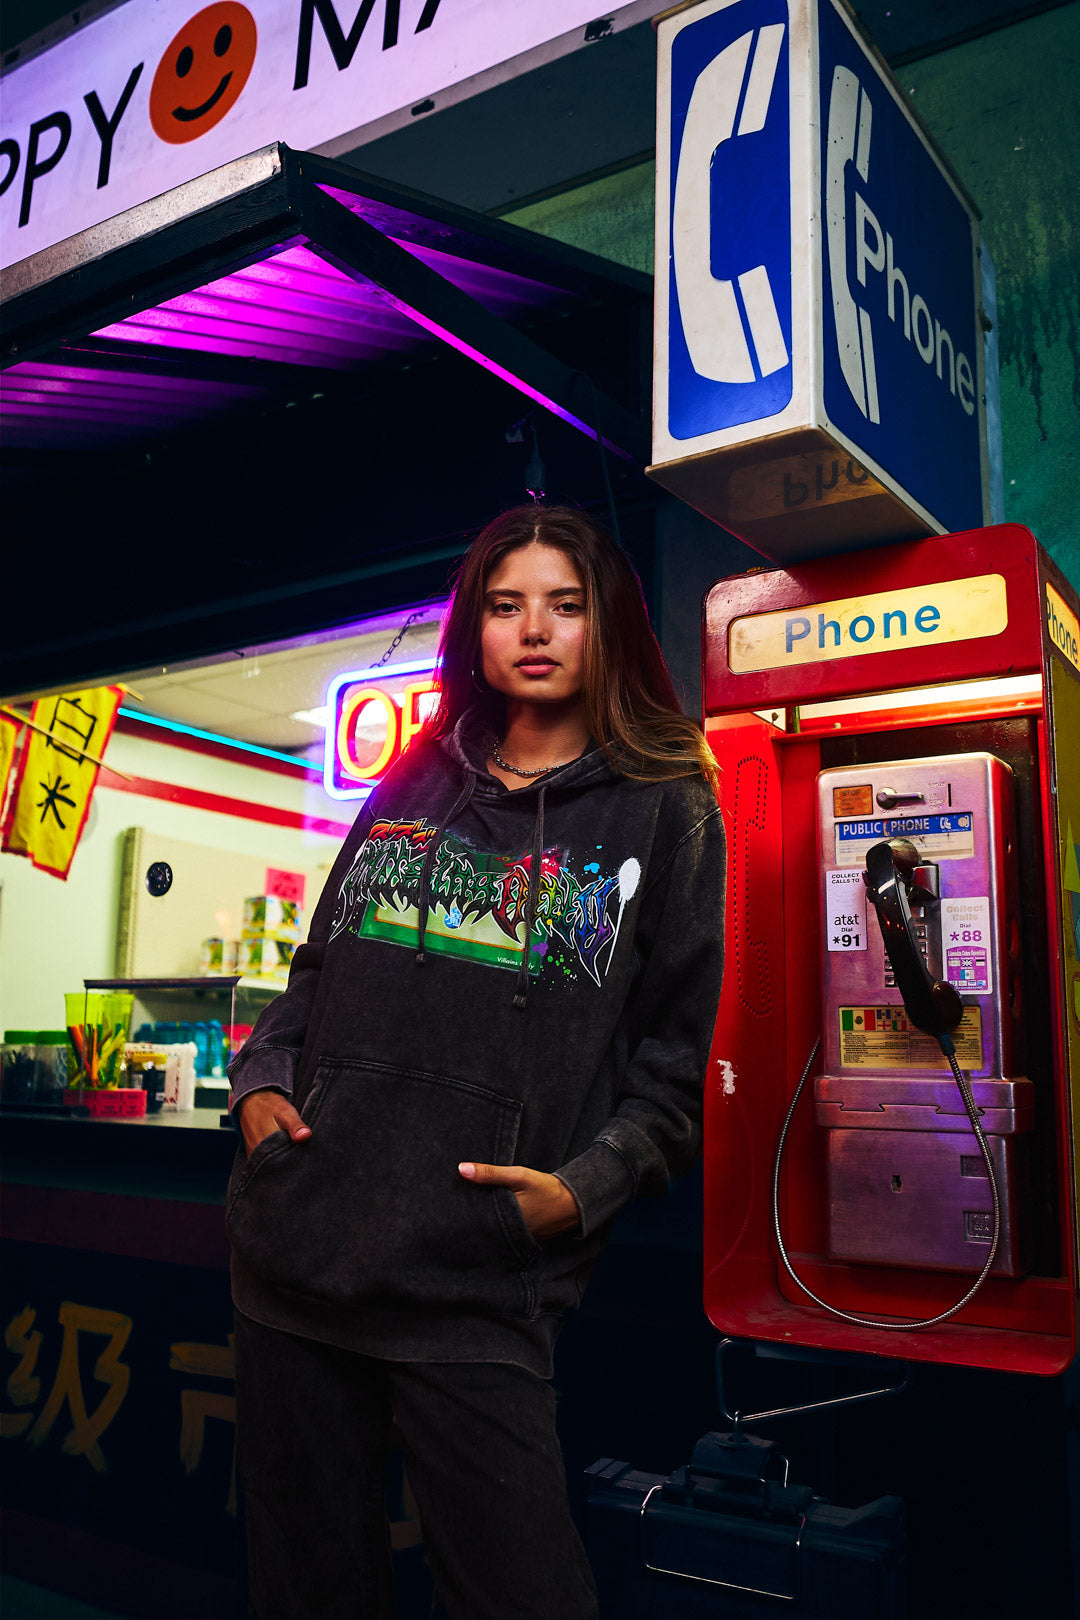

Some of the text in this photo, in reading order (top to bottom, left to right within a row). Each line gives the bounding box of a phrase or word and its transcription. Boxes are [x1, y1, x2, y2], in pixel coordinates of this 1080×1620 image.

[855, 191, 975, 416] Phone
[785, 605, 941, 654] Phone
[843, 818, 930, 836] PUBLIC PHONE
[946, 904, 984, 914] Collect
[834, 914, 860, 926] at&t
[952, 913, 979, 922] Calls
[497, 956, 518, 966] Villains
